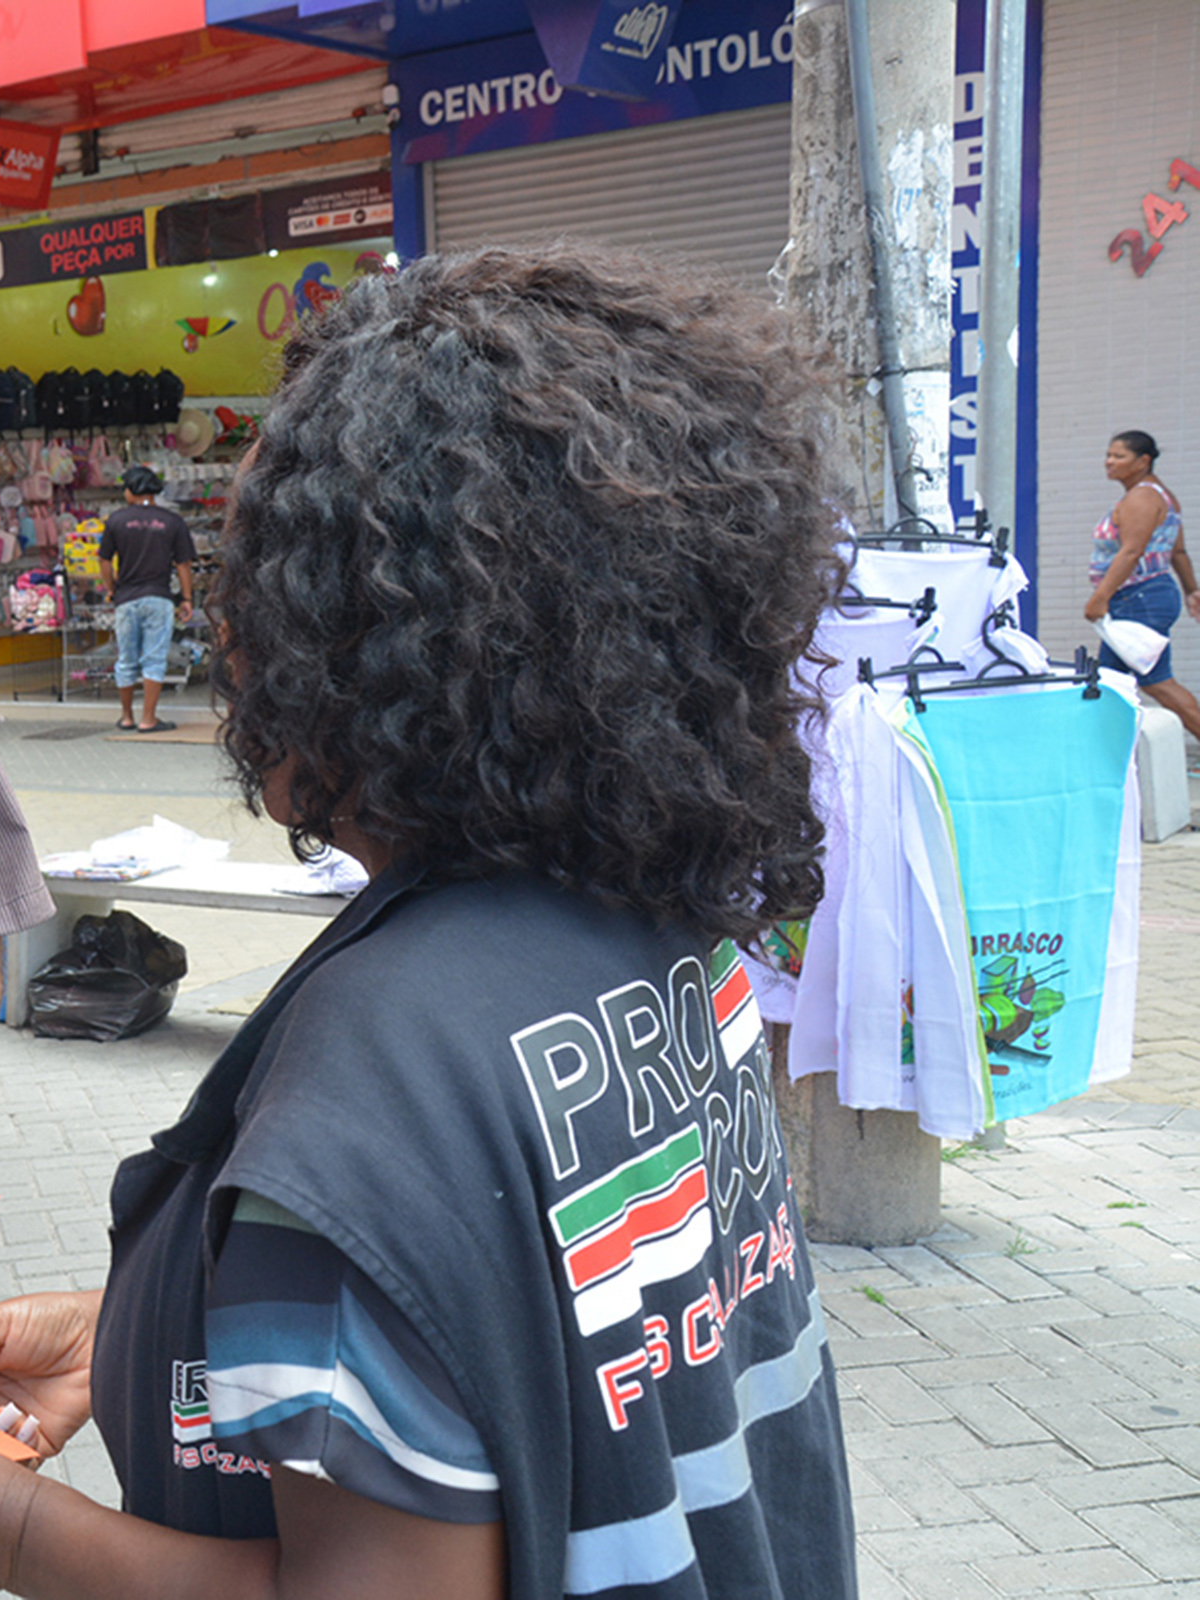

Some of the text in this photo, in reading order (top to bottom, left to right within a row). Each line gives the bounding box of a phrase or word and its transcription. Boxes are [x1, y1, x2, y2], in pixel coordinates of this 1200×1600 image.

[419, 68, 563, 127] CENTRO
[656, 13, 796, 84] NTOLÓ
[40, 215, 144, 255] QUALQUER
[51, 241, 135, 275] PEÇA POR
[1108, 157, 1200, 279] 241
[951, 71, 985, 526] DENTIST
[510, 957, 717, 1181] PRO
